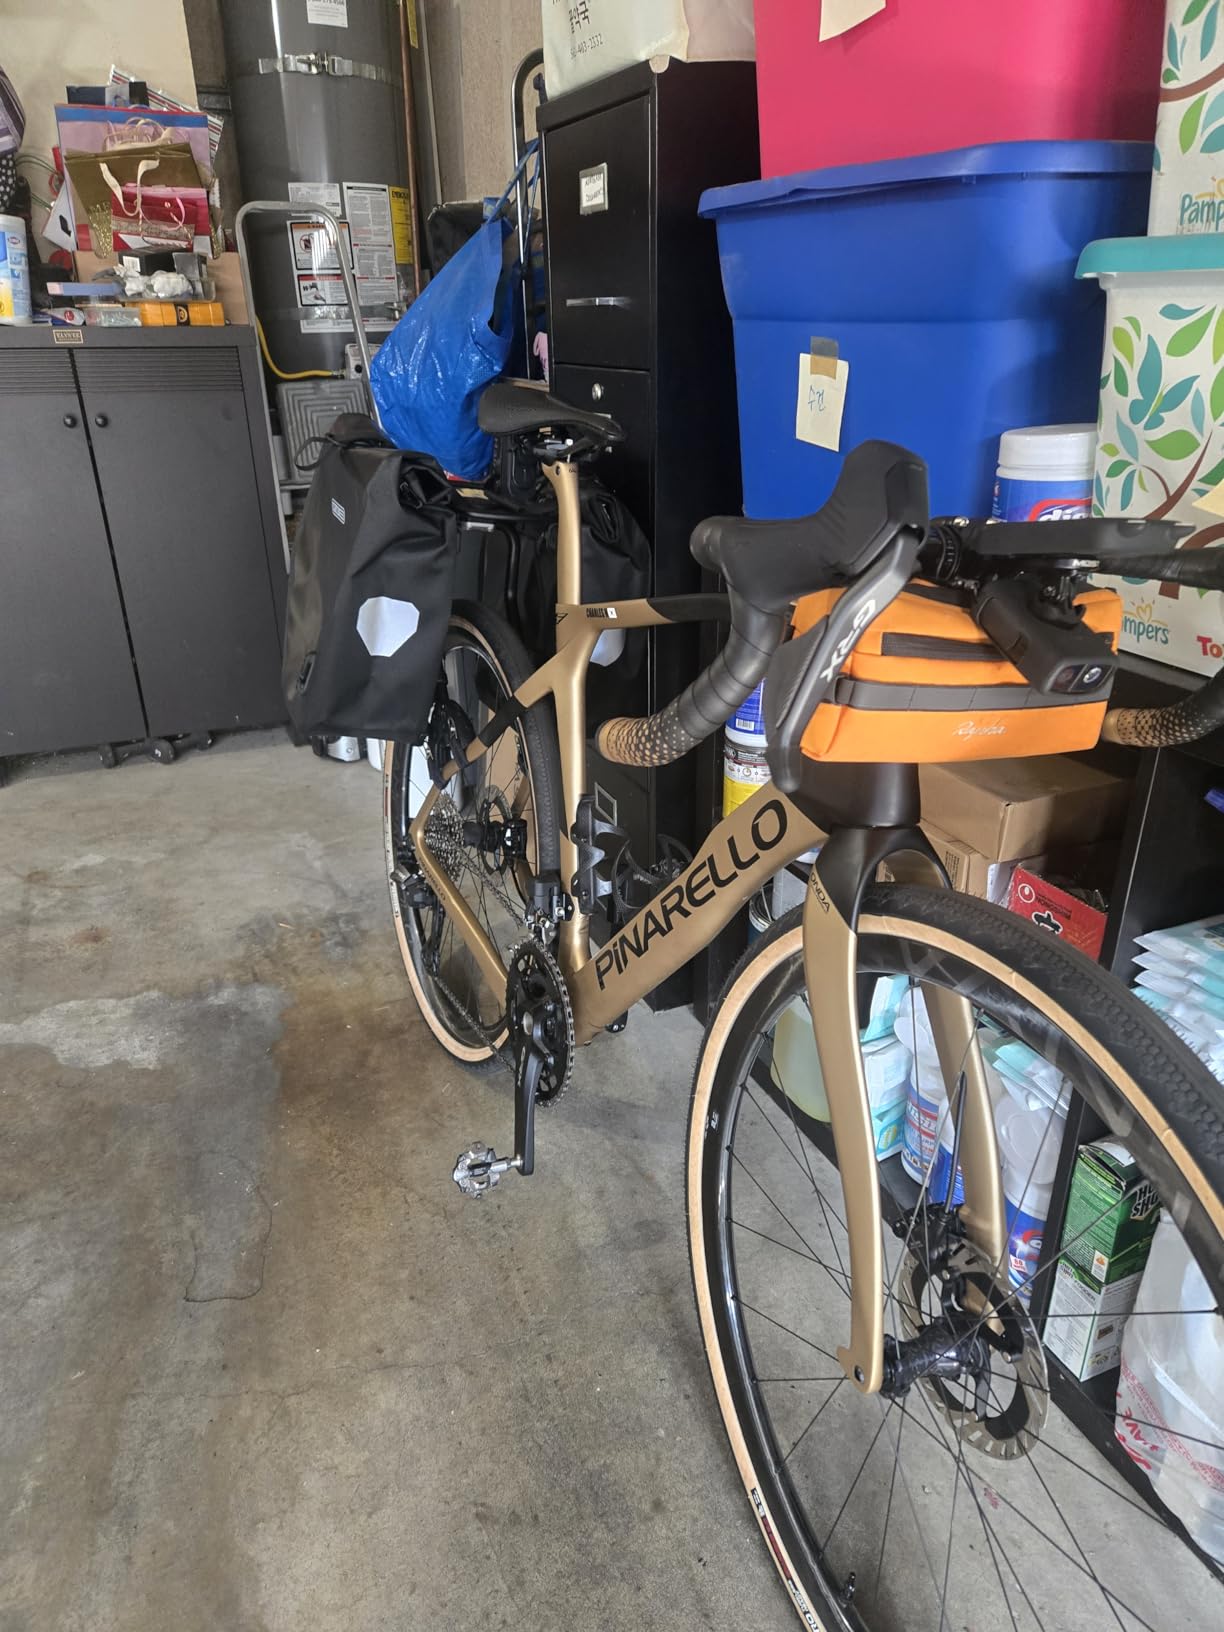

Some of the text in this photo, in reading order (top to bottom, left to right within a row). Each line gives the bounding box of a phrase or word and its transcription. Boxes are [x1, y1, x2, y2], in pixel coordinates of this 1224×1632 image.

[820, 599, 876, 683] GRX
[1121, 615, 1169, 645] mpers
[1196, 635, 1224, 659] To
[810, 871, 830, 912] ONDA
